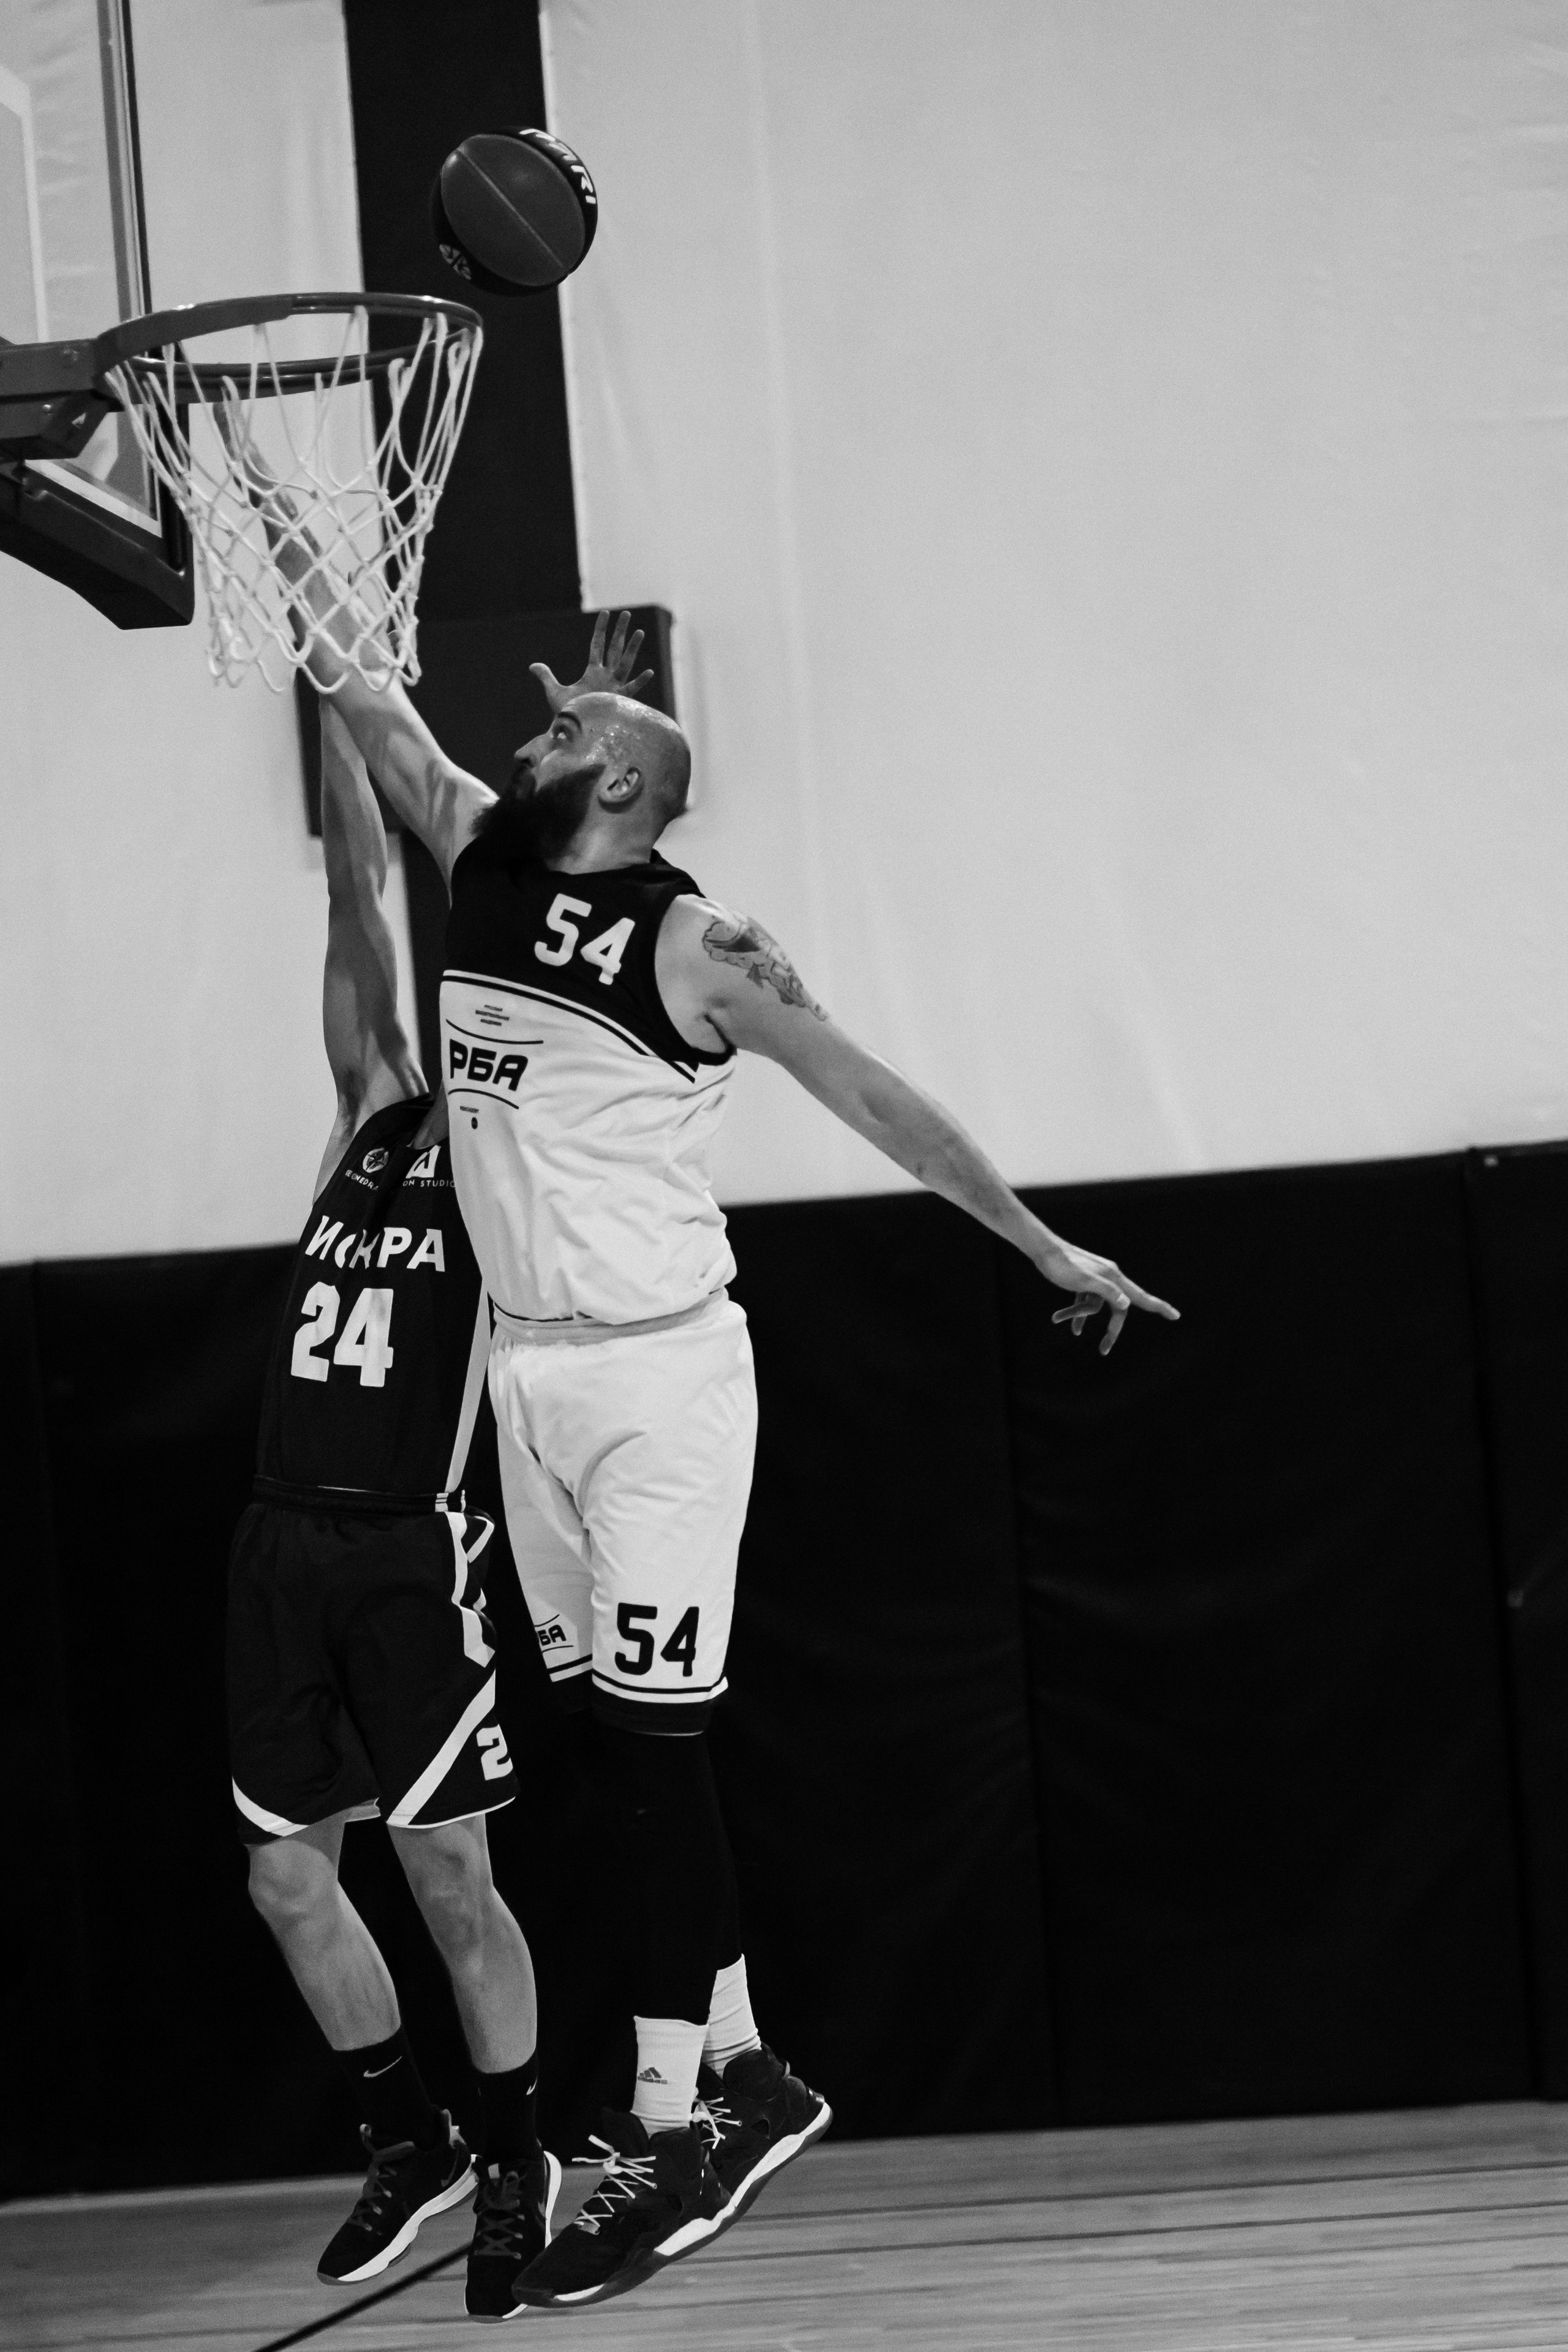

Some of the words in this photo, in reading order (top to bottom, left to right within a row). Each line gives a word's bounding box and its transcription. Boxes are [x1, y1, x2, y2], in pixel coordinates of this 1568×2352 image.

[534, 893, 636, 986] 54
[450, 1038, 529, 1091] РБА
[291, 1281, 394, 1387] 24
[536, 1624, 567, 1646] БА
[614, 1602, 699, 1677] 54
